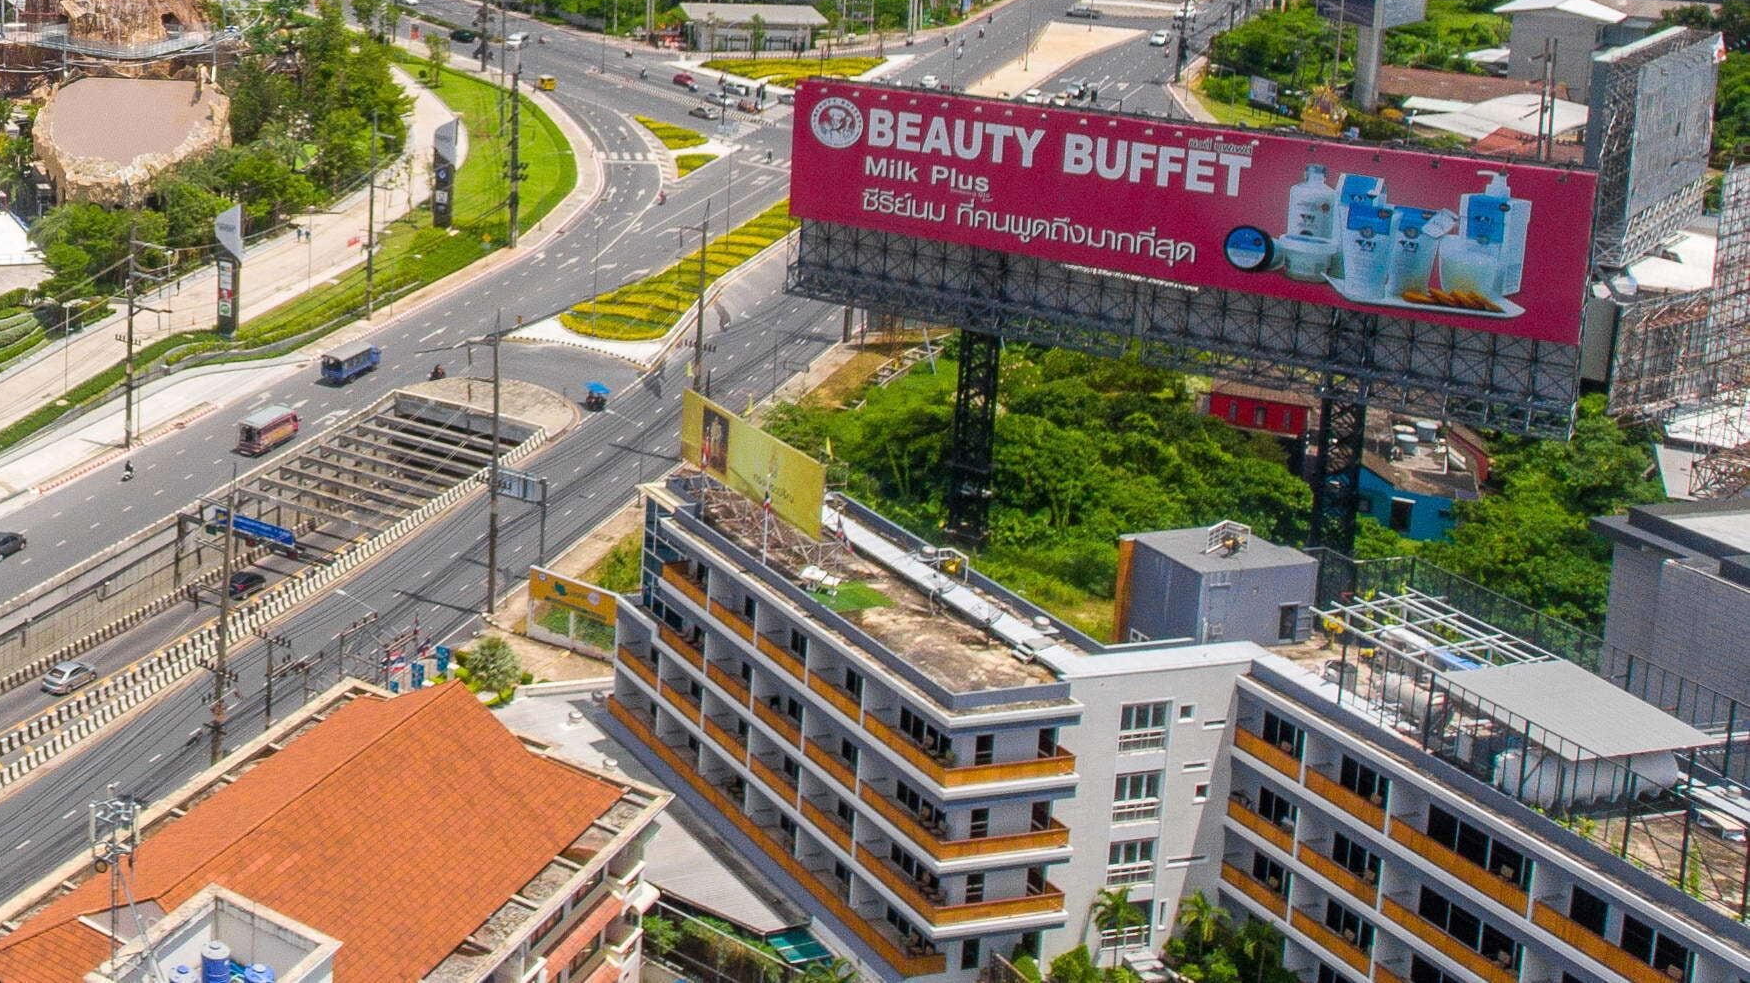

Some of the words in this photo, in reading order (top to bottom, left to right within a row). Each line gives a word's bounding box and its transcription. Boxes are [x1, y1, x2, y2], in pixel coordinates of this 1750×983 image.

[865, 156, 919, 182] Milk
[931, 165, 989, 192] Plus
[867, 108, 1046, 168] BEAUTY
[1063, 133, 1251, 196] BUFFET
